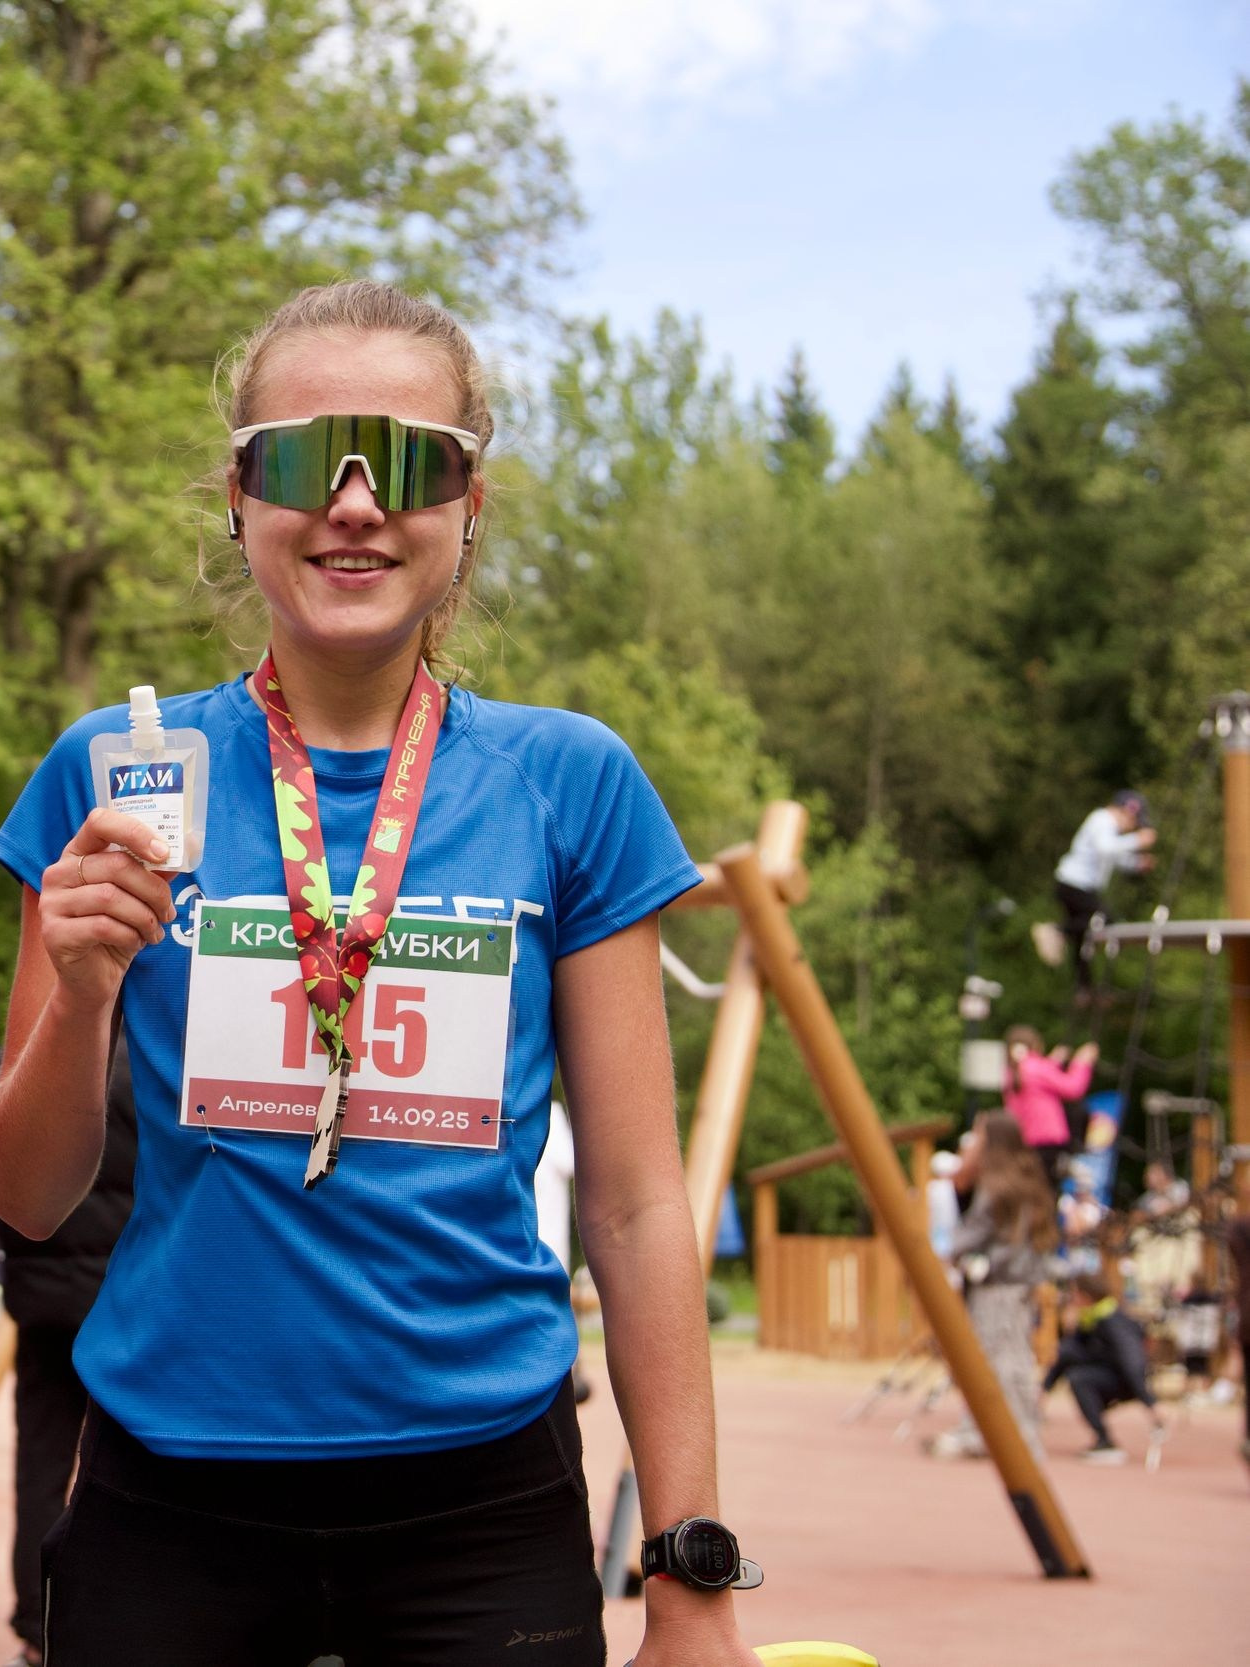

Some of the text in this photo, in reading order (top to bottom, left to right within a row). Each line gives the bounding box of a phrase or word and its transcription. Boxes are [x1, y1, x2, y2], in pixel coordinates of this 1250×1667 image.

[392, 692, 432, 802] АПРЕЛЕВКА
[116, 769, 174, 791] УГЛИ
[368, 1105, 469, 1128] 14.09.25
[529, 1624, 584, 1643] DEMIX
